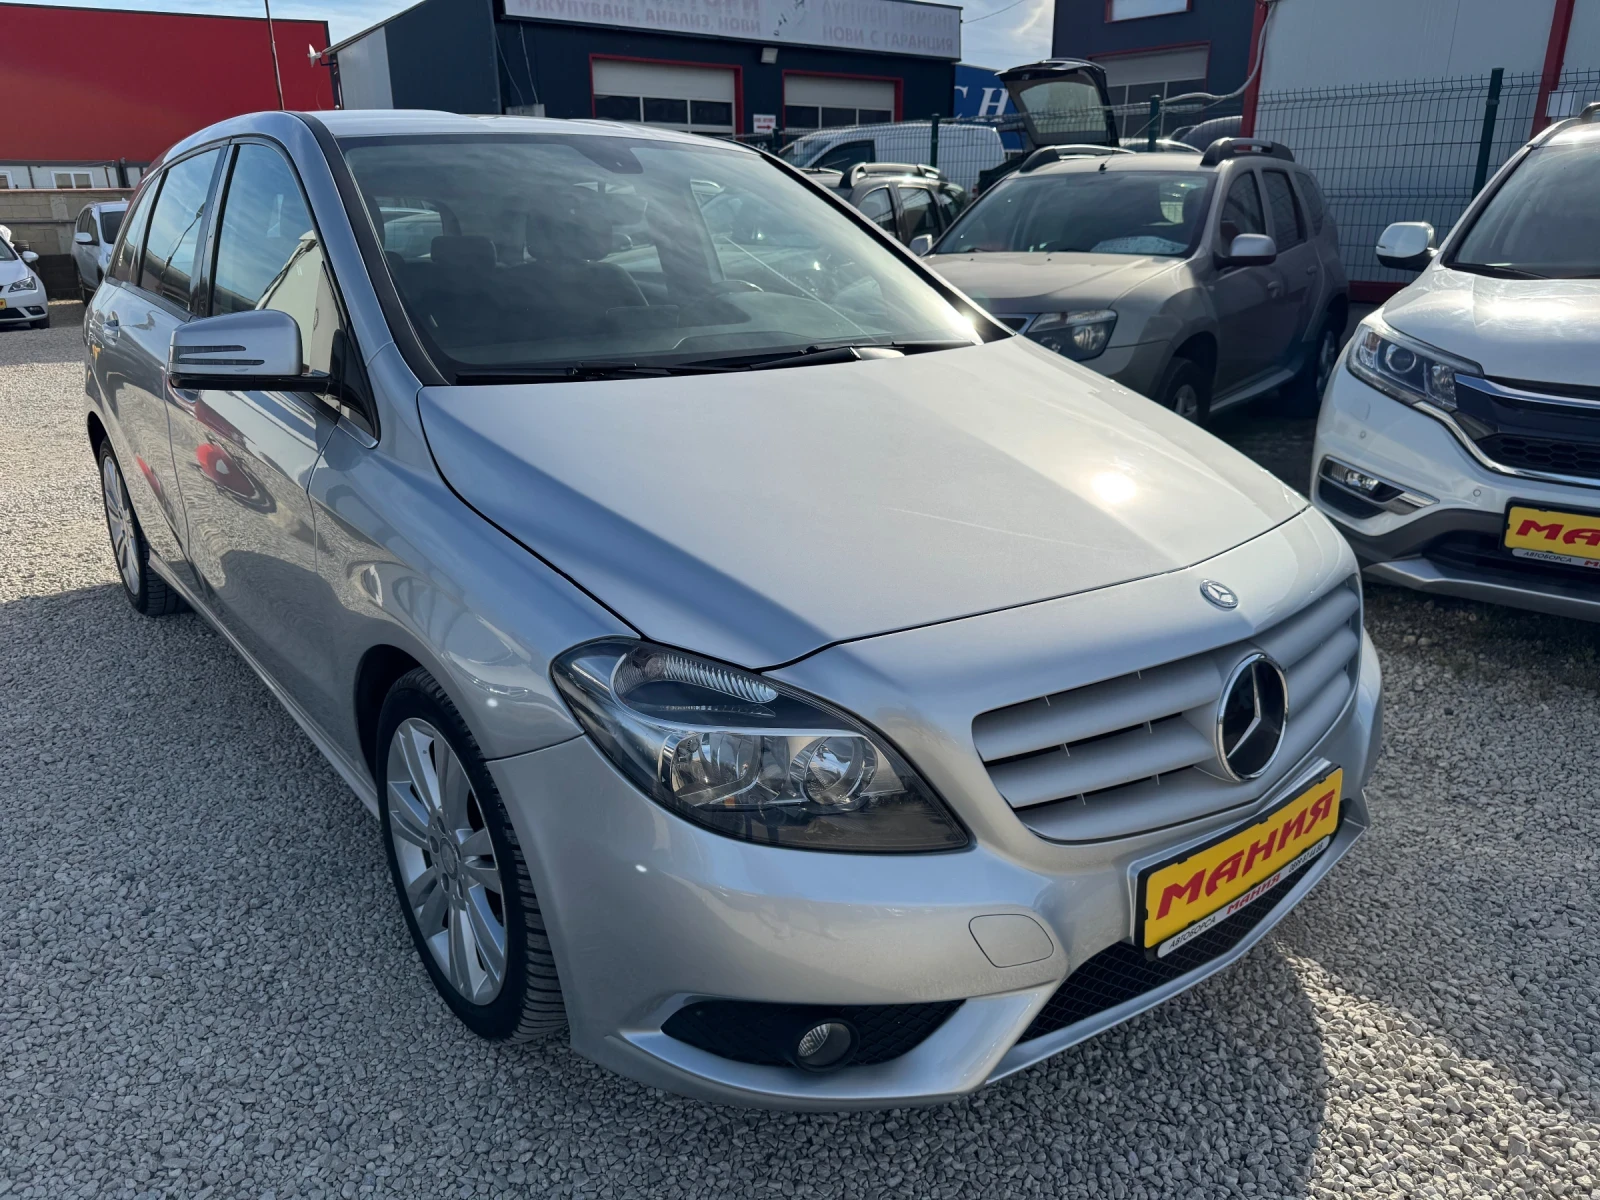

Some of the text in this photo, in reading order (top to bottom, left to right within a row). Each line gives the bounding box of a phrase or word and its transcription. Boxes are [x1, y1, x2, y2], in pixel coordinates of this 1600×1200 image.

[718, 16, 761, 32] НОВИ
[822, 26, 864, 43] НОВИ
[884, 32, 953, 51] ГАРАНЦИЯ
[1523, 551, 1572, 563] АВТОБОРСА
[1156, 789, 1335, 920] МАНИЯ
[1169, 916, 1216, 950] АВТОБОРСА
[1227, 873, 1281, 915] МАНИЯ
